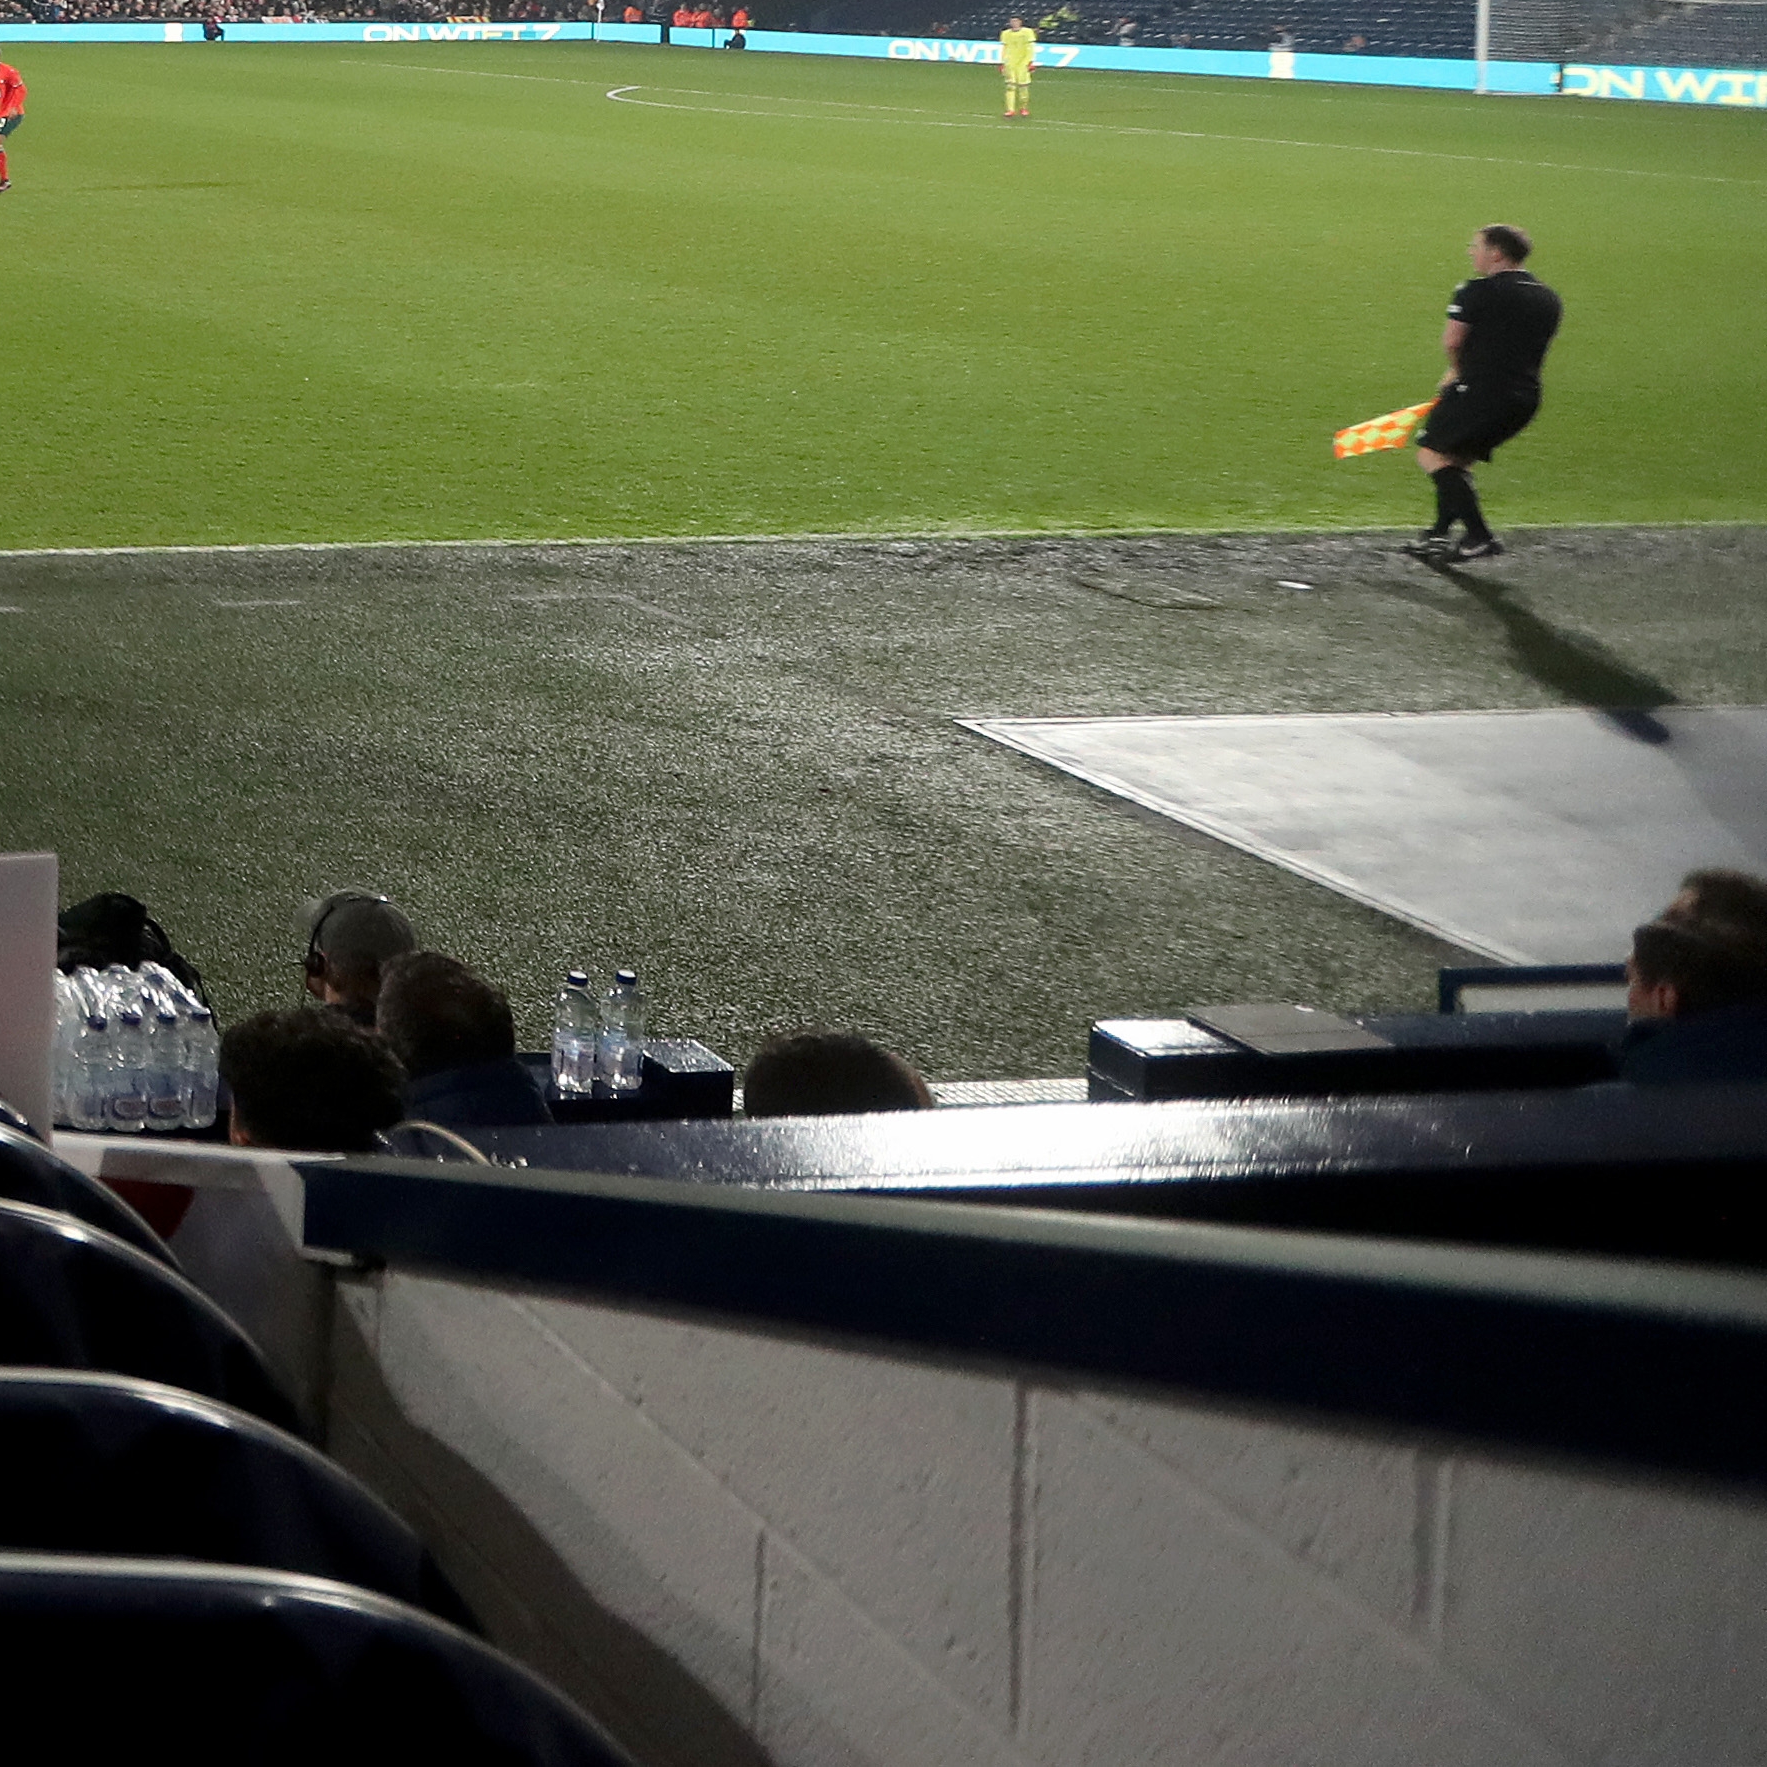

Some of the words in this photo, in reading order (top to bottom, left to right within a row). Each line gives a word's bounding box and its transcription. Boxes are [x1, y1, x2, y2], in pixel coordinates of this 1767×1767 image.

[363, 25, 420, 42] ON
[530, 23, 561, 41] 7
[888, 39, 940, 61] ON
[1049, 46, 1081, 68] 7
[1562, 67, 1644, 100] ON
